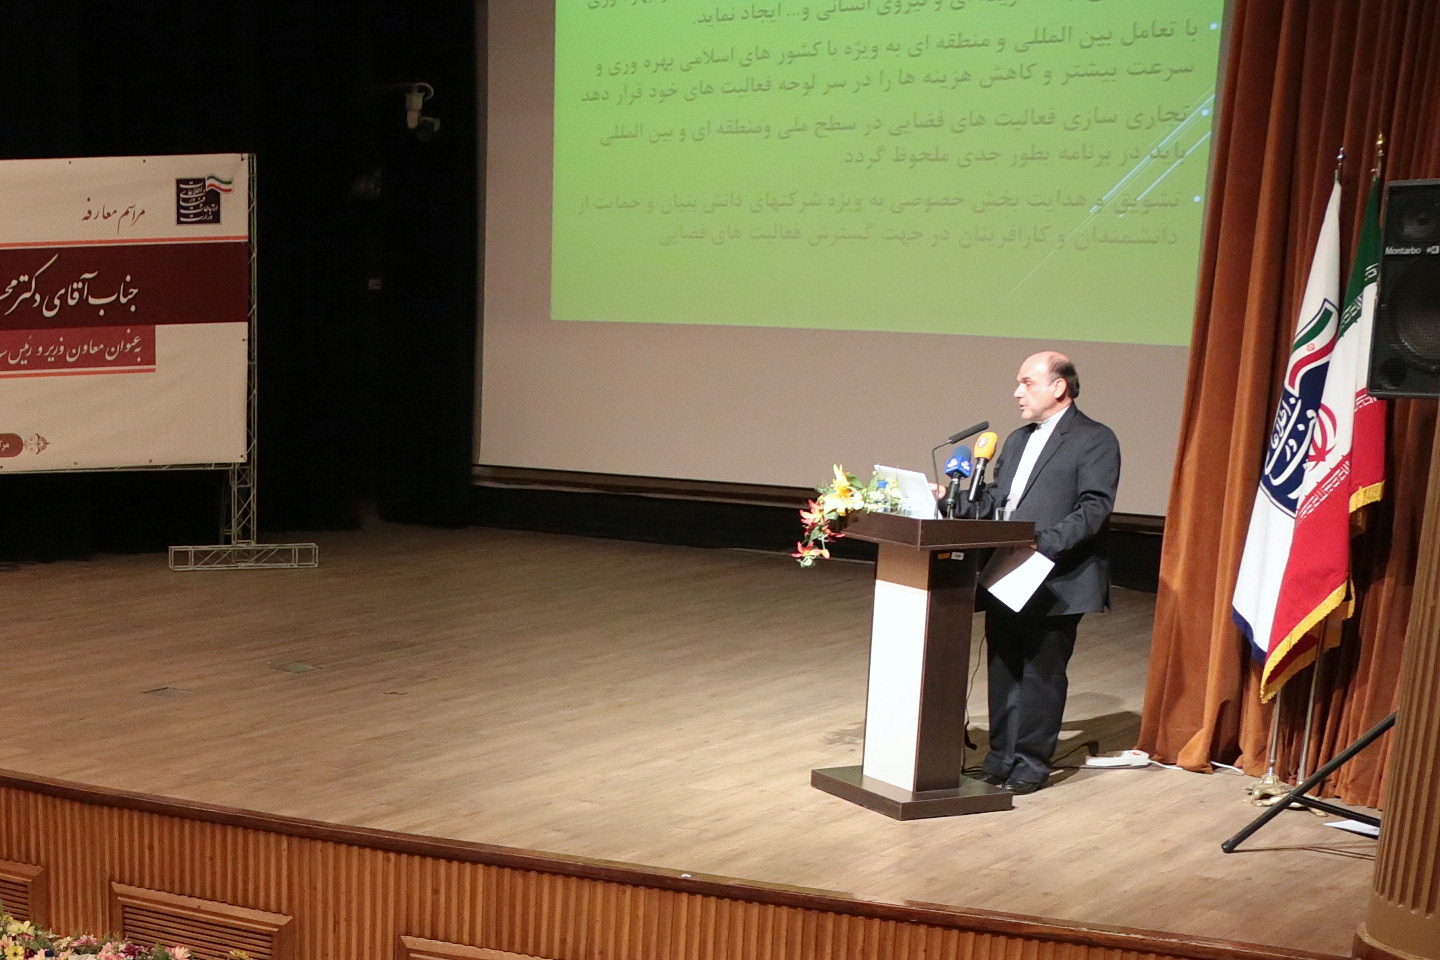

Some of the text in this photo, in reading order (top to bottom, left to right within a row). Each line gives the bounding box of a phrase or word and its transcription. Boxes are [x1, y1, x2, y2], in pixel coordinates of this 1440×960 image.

[936, 33, 990, 50] منطقه
[1014, 26, 1073, 52] المللی
[1079, 27, 1113, 49] بین
[1120, 20, 1178, 46] تعامل
[898, 69, 915, 85] ها
[979, 63, 1038, 88] کاهش
[1060, 62, 1117, 86] بیشتر
[4, 253, 59, 315] دکتر
[42, 270, 99, 318] آقای
[88, 275, 139, 316] جناب
[66, 339, 104, 362] معاون
